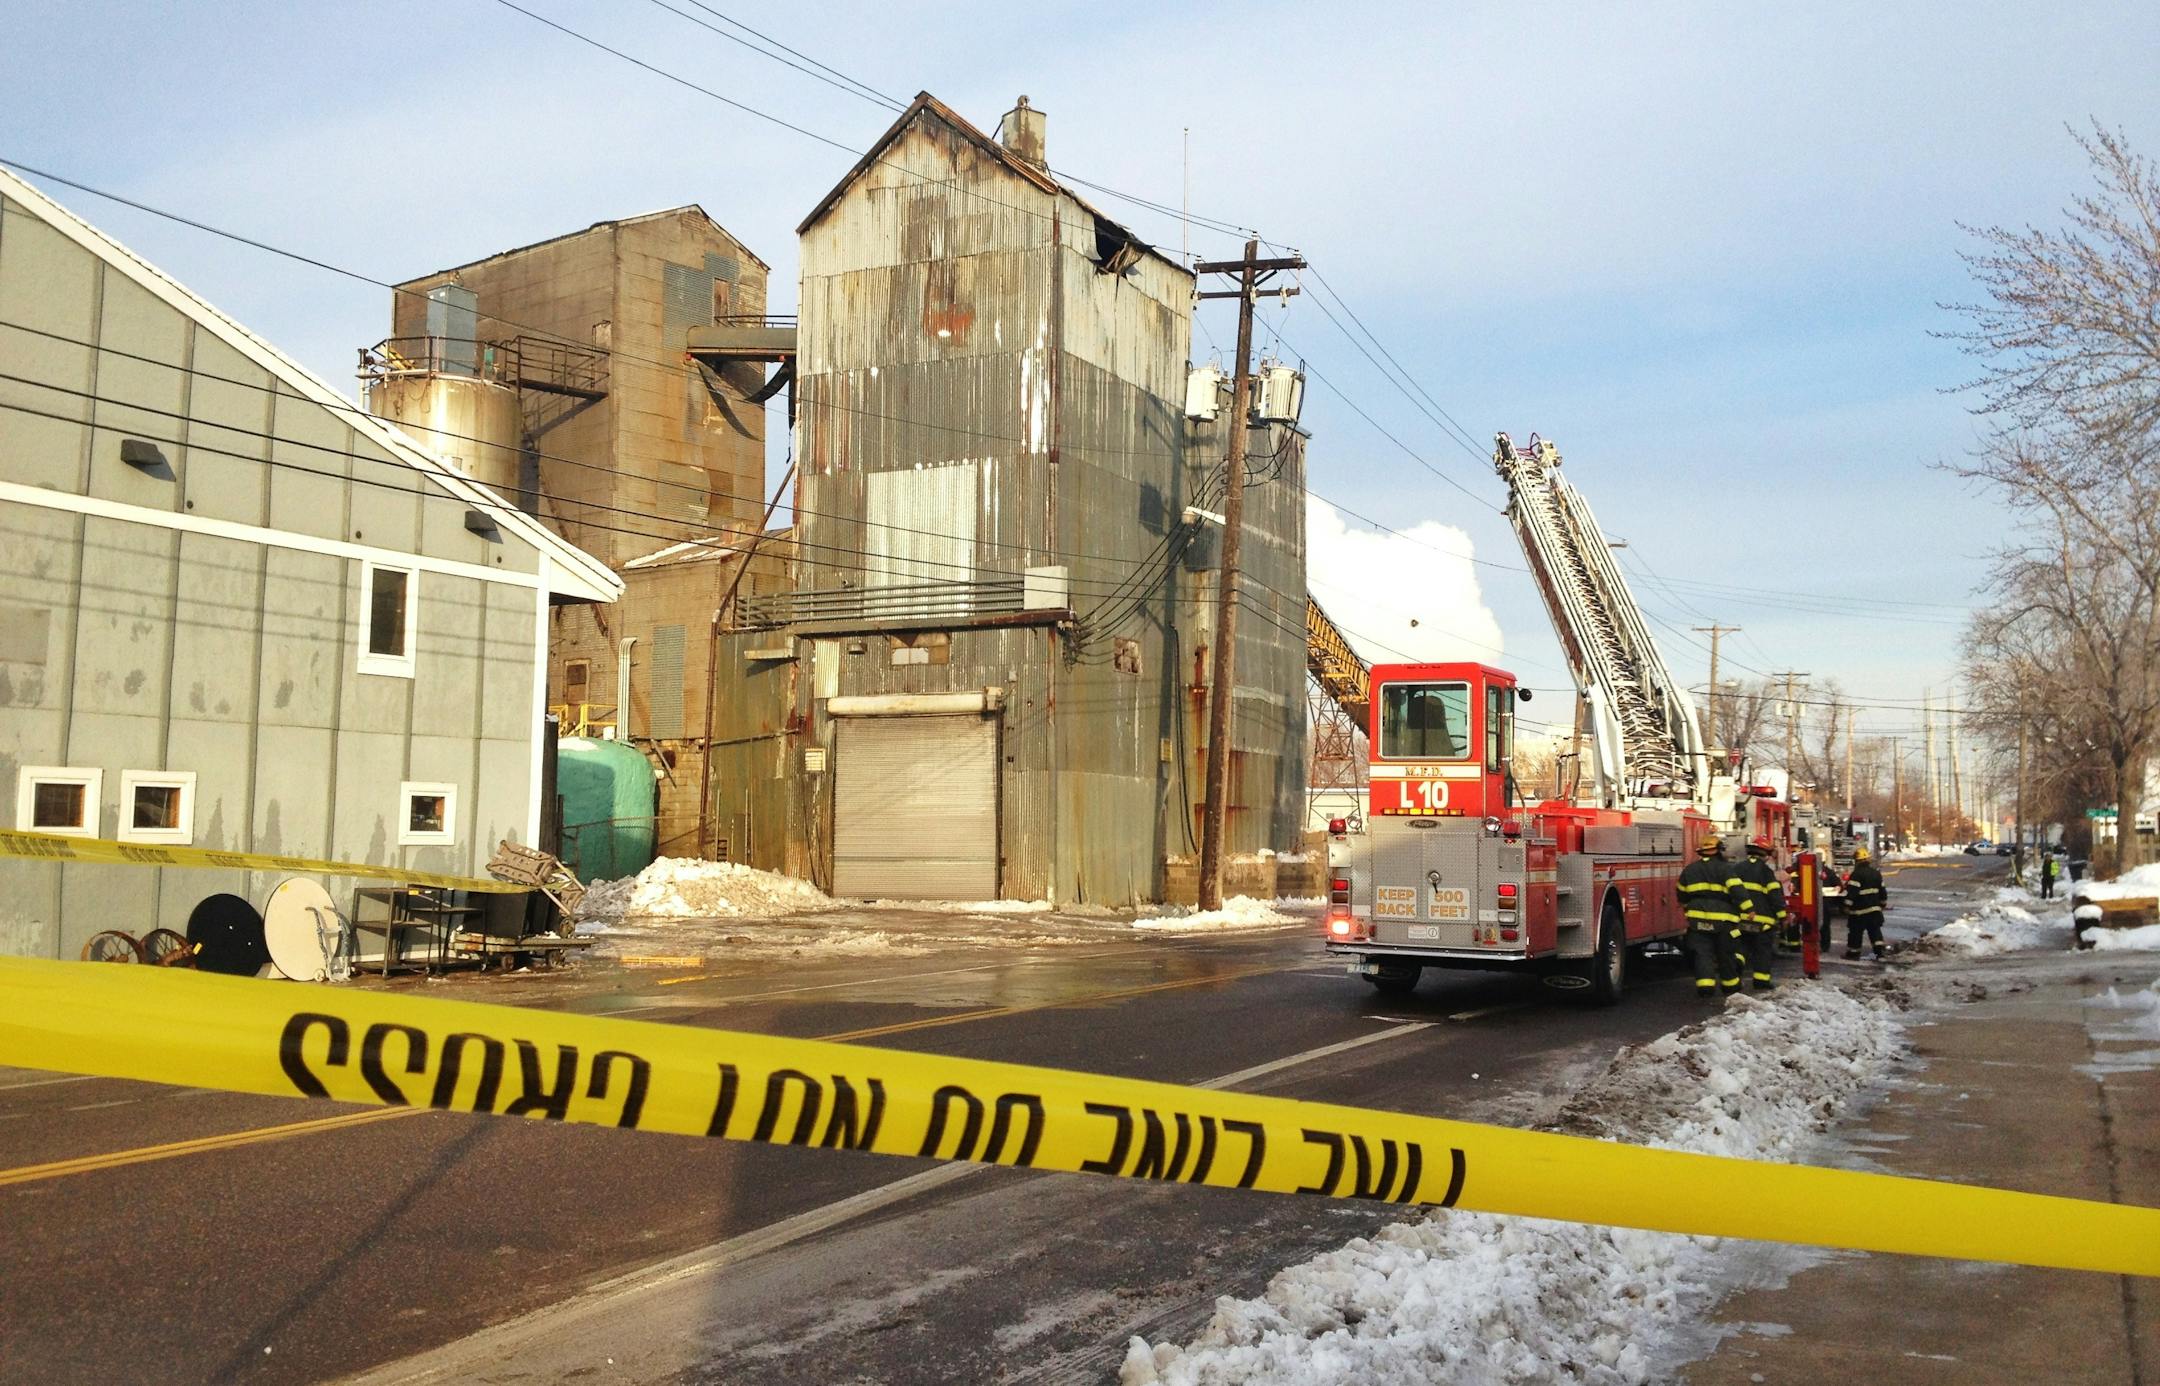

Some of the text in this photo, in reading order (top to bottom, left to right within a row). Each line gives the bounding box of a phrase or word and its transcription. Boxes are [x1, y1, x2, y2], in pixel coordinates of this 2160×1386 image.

[1400, 781, 1449, 809] L 10
[1378, 888, 1415, 901] KEEP
[1434, 890, 1464, 903] 500
[1376, 902, 1415, 916] BACK
[1430, 904, 1468, 918] FEET
[278, 1011, 650, 1127] CROSS
